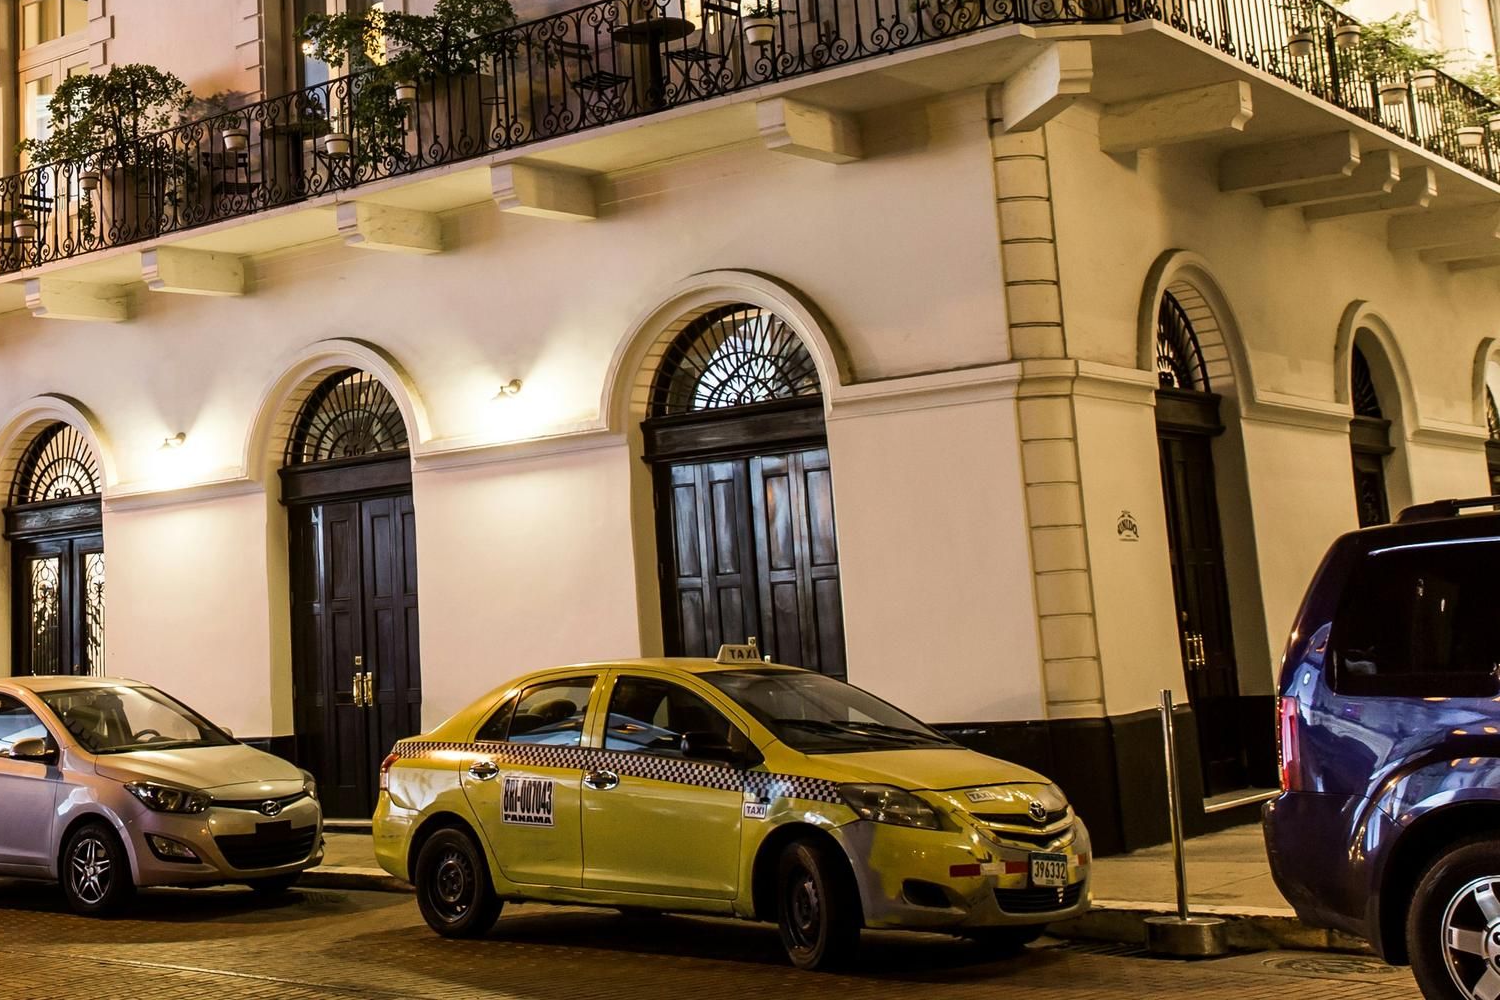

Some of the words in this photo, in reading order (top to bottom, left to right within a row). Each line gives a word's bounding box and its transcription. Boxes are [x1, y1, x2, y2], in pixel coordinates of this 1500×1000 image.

[729, 649, 758, 659] TAXI
[504, 779, 553, 815] 8RI-007043
[969, 792, 994, 800] TAXI
[746, 805, 765, 815] TAXI
[504, 814, 552, 824] PANAMA
[1034, 861, 1066, 879] 396332
